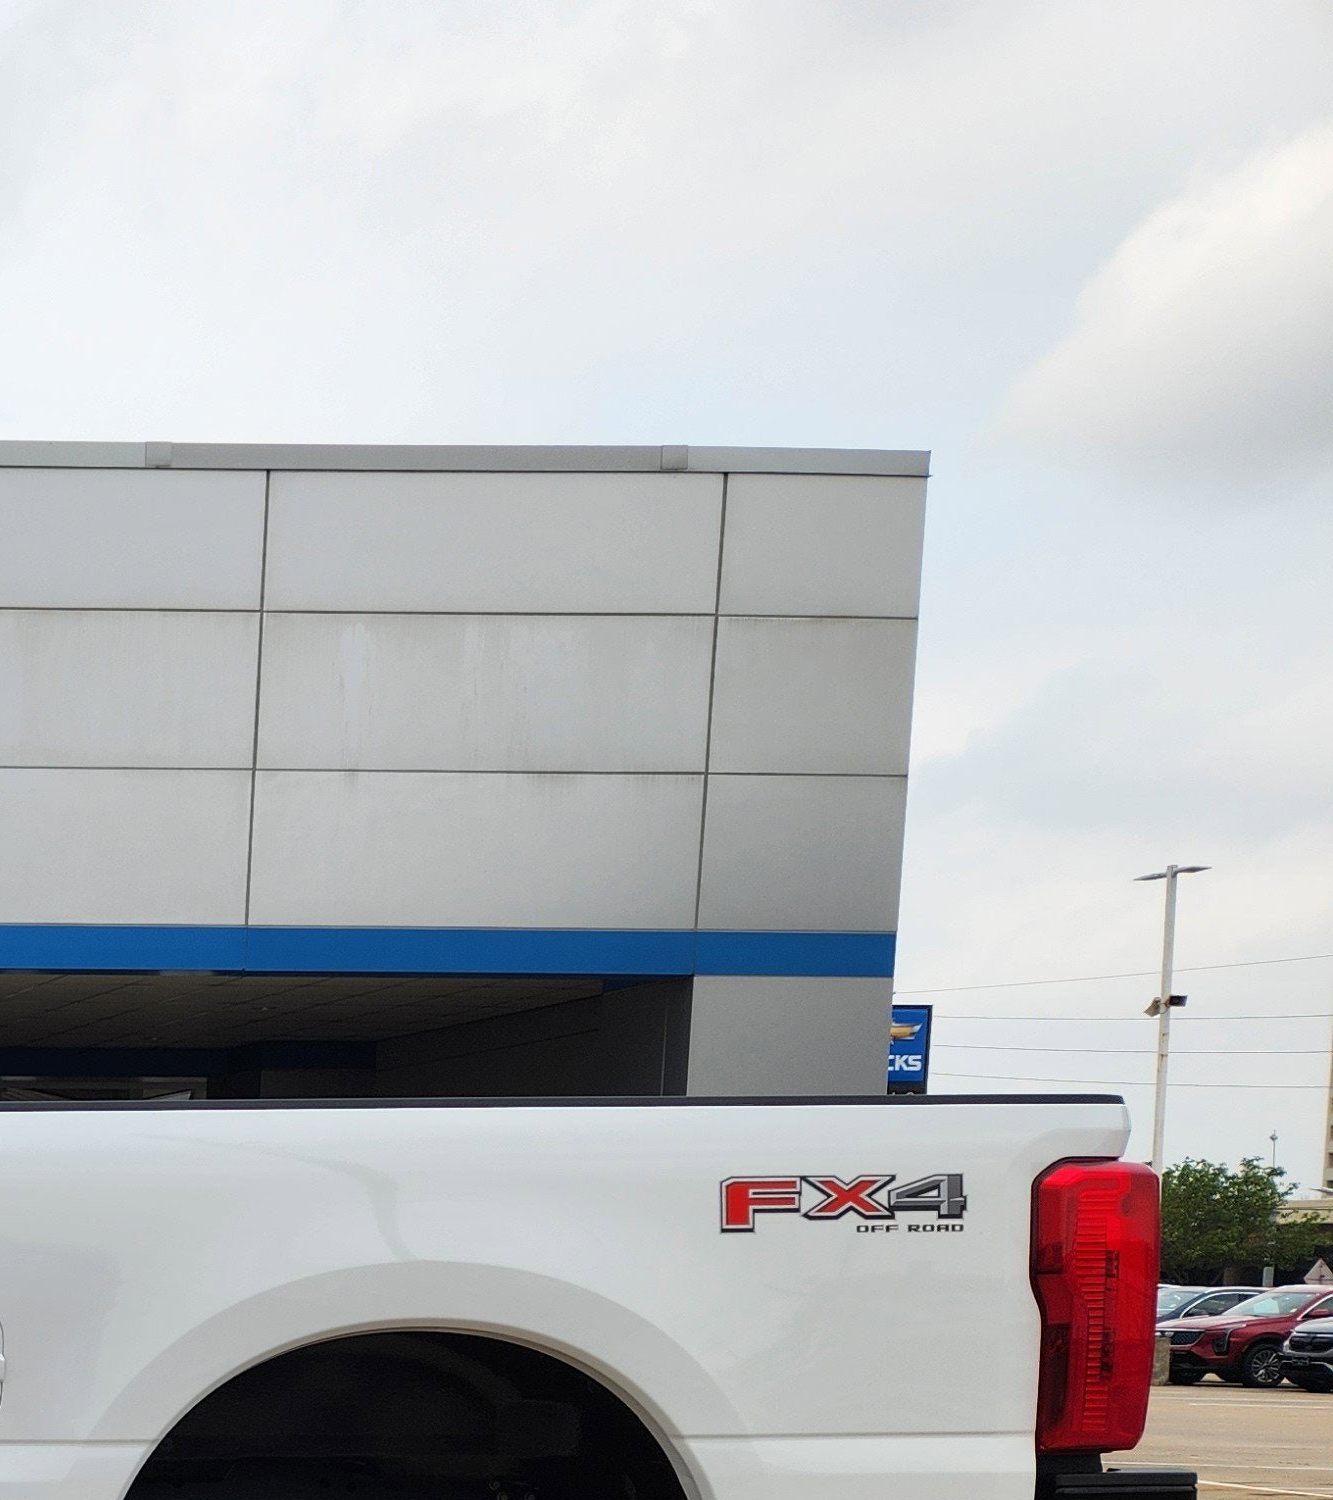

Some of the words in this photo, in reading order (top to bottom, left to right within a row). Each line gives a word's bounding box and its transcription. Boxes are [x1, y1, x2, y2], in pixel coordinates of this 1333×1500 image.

[720, 1173, 967, 1234] FX4
[856, 1224, 899, 1233] OFF
[907, 1224, 965, 1233] ROAD
